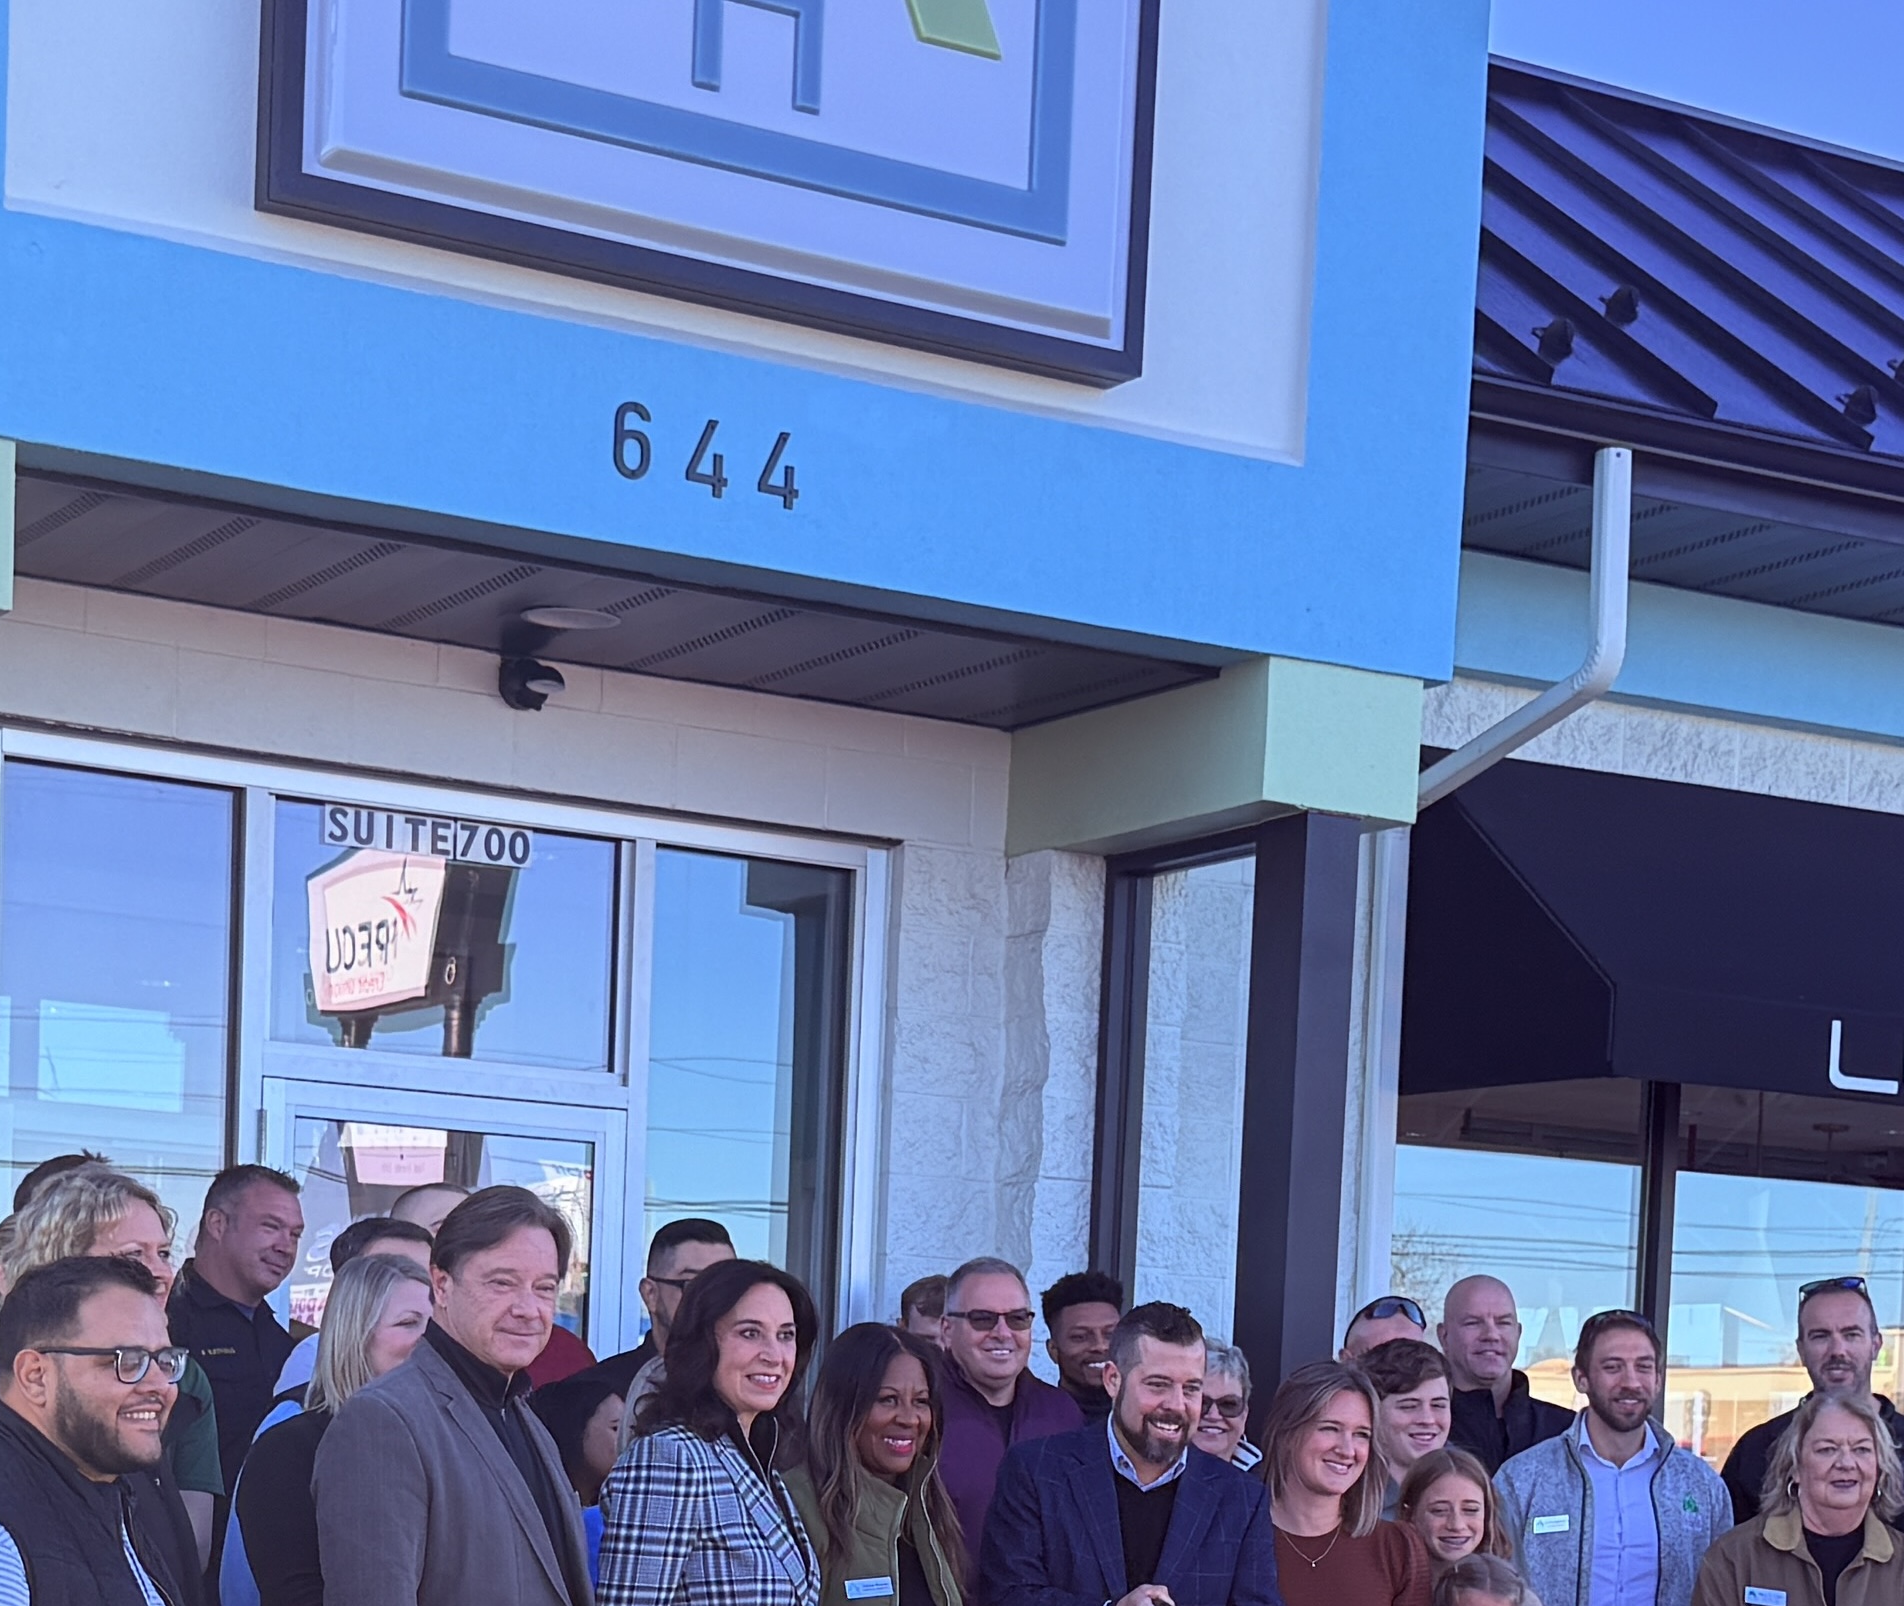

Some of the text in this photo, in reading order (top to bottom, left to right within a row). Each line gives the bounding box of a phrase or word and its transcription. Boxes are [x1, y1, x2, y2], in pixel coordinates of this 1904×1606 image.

[613, 401, 799, 510] 644
[328, 807, 530, 865] SUITE 700
